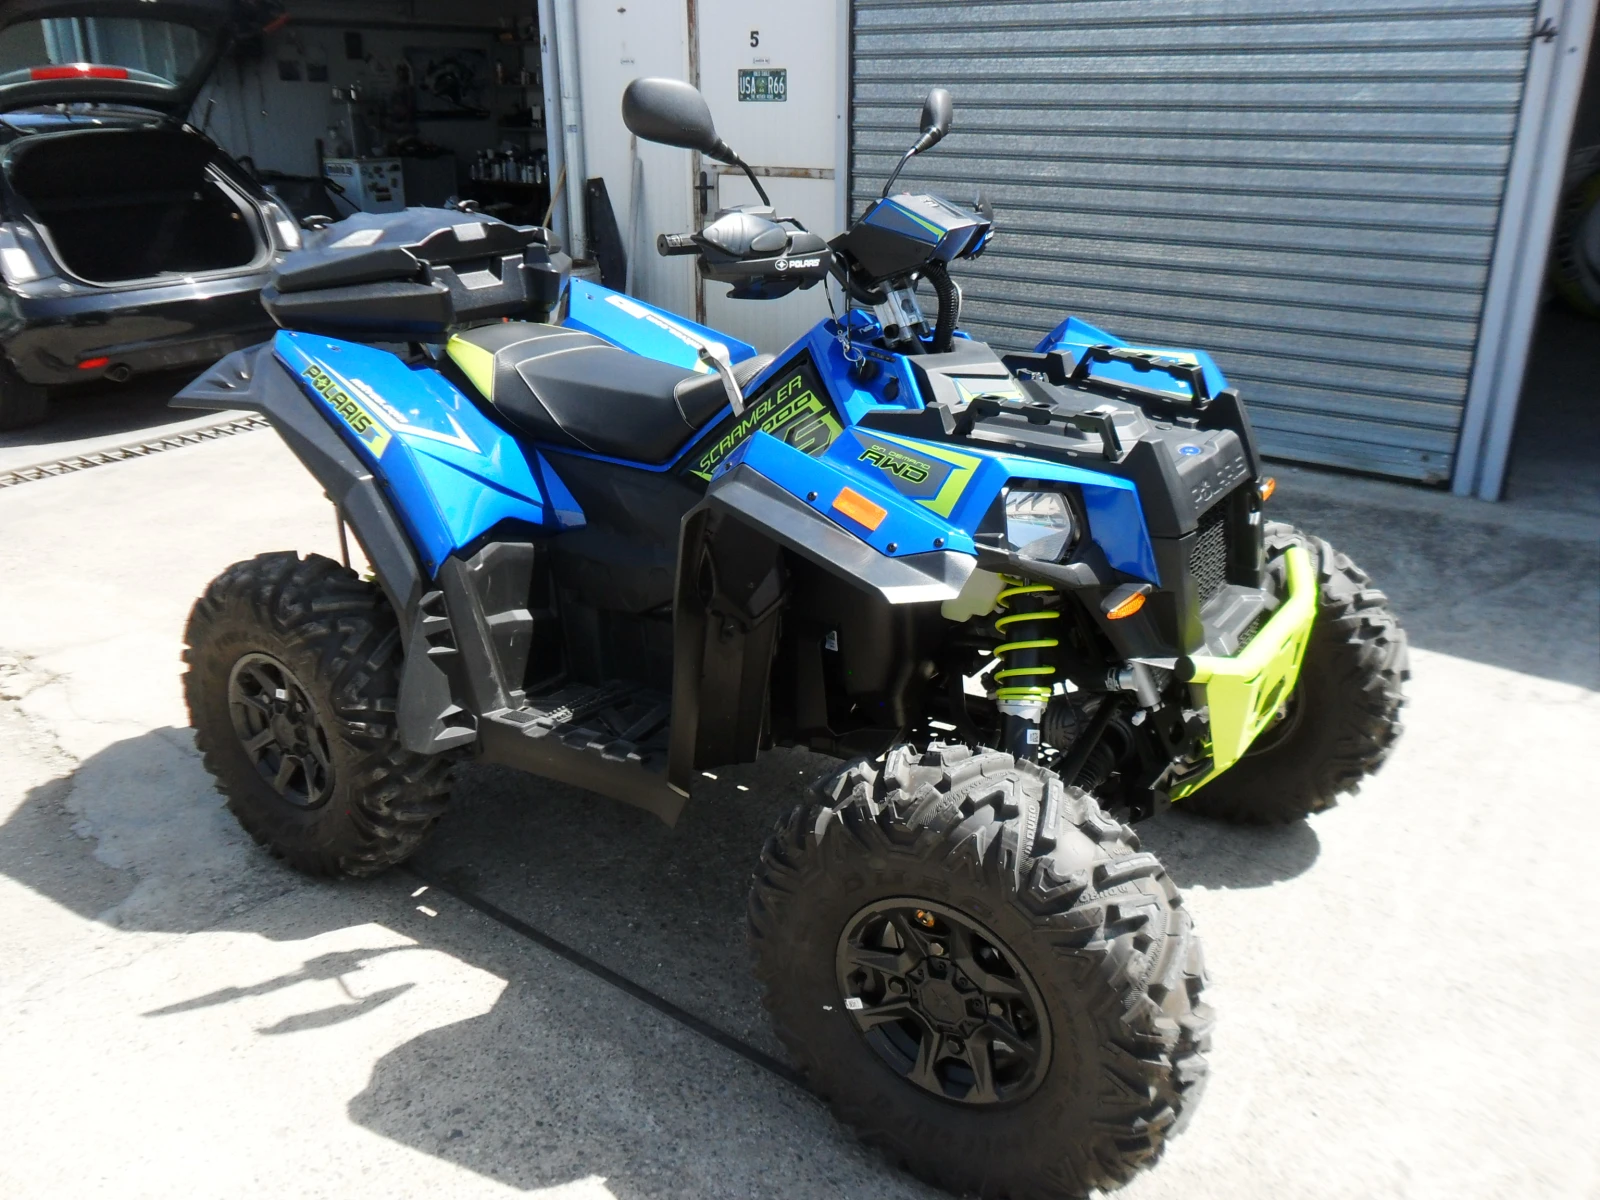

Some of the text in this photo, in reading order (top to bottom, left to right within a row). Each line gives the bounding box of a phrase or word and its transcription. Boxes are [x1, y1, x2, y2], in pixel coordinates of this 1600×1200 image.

[750, 31, 759, 47] 5
[740, 76, 785, 94] USA R66
[789, 259, 821, 269] POLARIS
[301, 363, 373, 434] POLARIS
[699, 375, 802, 474] SCRAMBLER
[857, 448, 929, 484] AWD
